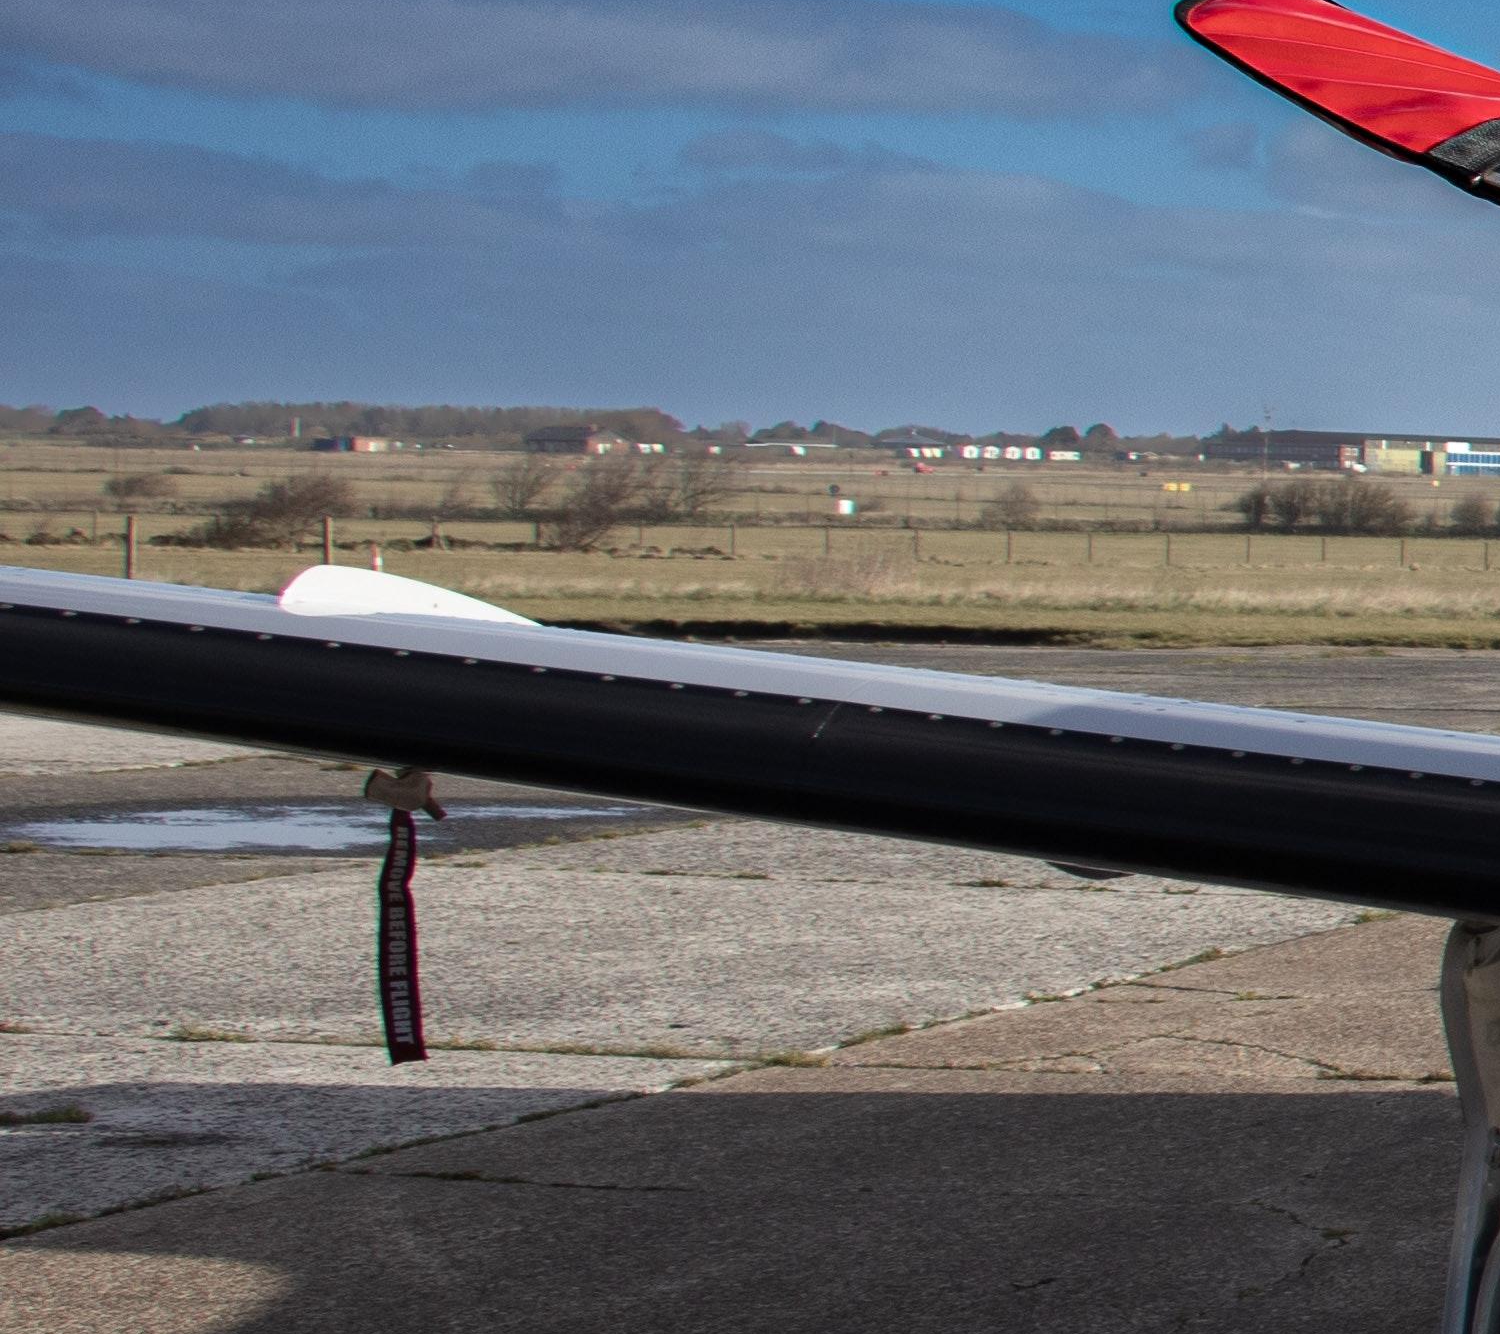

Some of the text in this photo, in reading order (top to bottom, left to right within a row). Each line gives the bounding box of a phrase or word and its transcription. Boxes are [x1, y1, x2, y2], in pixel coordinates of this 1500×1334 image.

[388, 826, 414, 1045] REMOVE BEFORE FLIGHT
